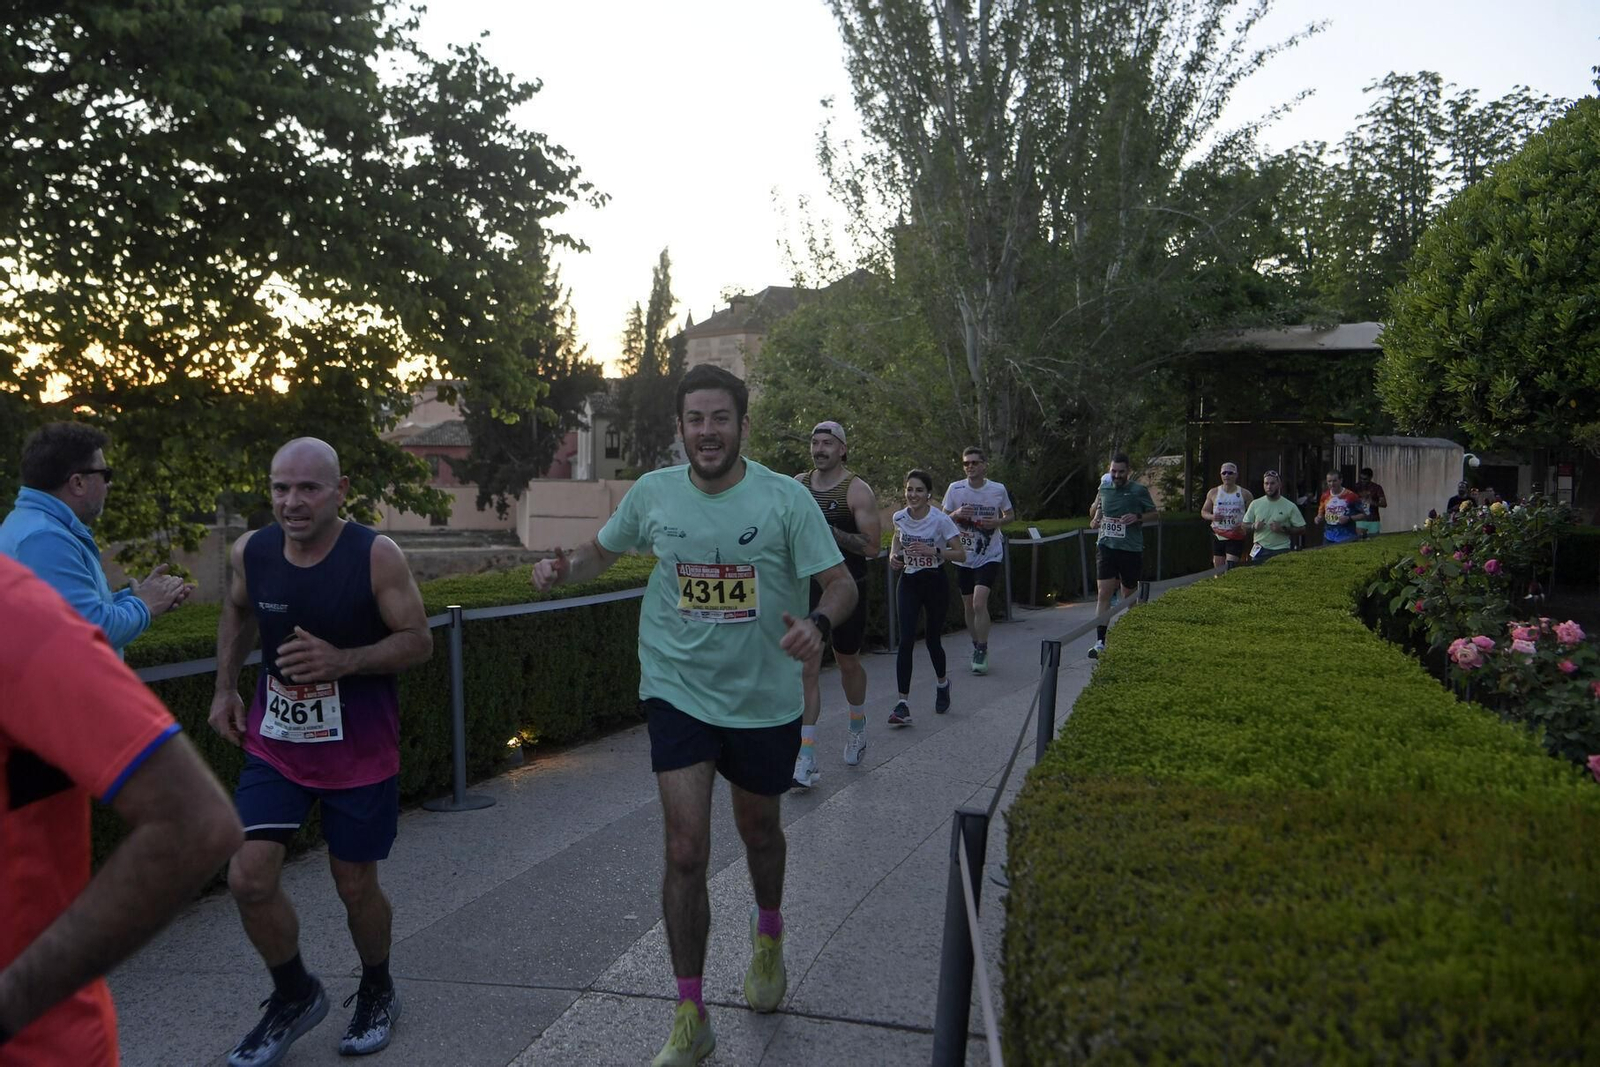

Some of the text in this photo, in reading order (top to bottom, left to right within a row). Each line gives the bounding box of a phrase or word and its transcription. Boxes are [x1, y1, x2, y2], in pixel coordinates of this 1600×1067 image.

[679, 564, 691, 576] 40
[907, 556, 933, 567] 2158
[683, 579, 747, 604] 4314
[269, 695, 325, 725] 4261
